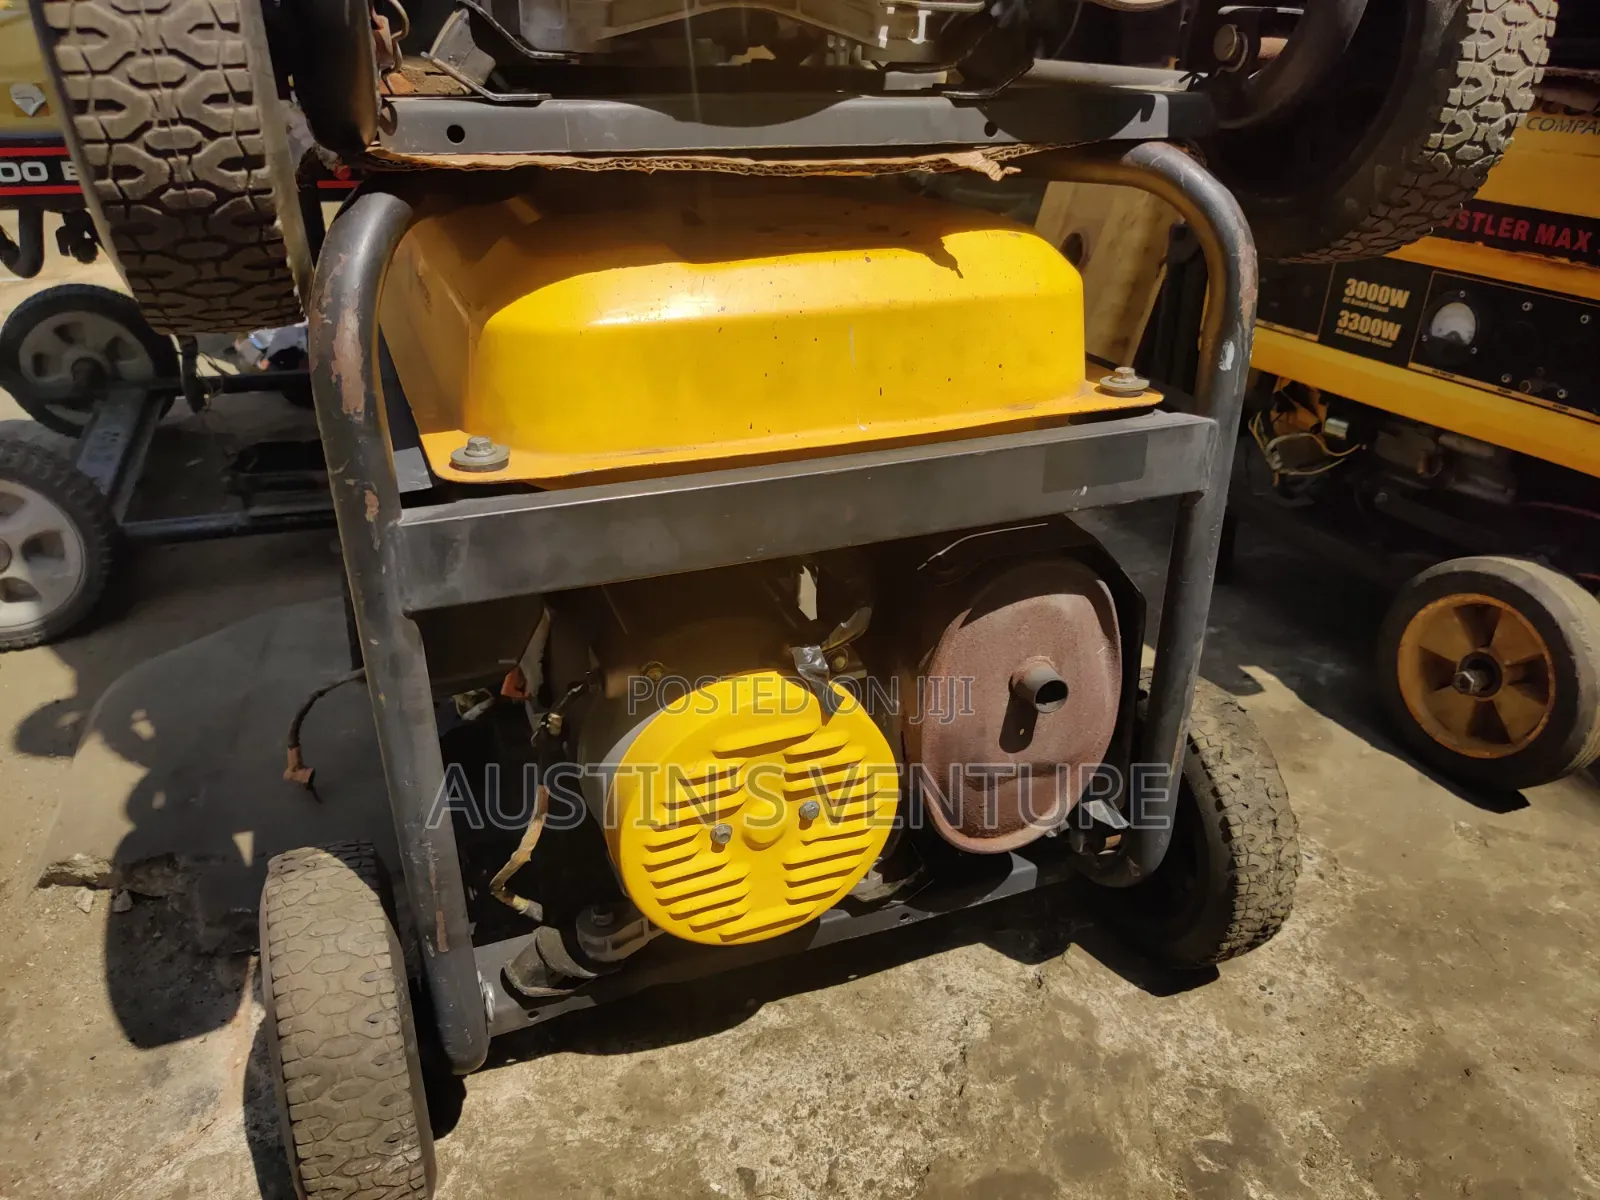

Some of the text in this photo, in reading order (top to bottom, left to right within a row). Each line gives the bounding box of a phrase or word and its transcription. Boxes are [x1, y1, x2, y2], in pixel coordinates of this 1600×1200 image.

[1534, 223, 1592, 252] MAX
[1344, 278, 1410, 308] 3000W
[1337, 310, 1402, 341] 3300W
